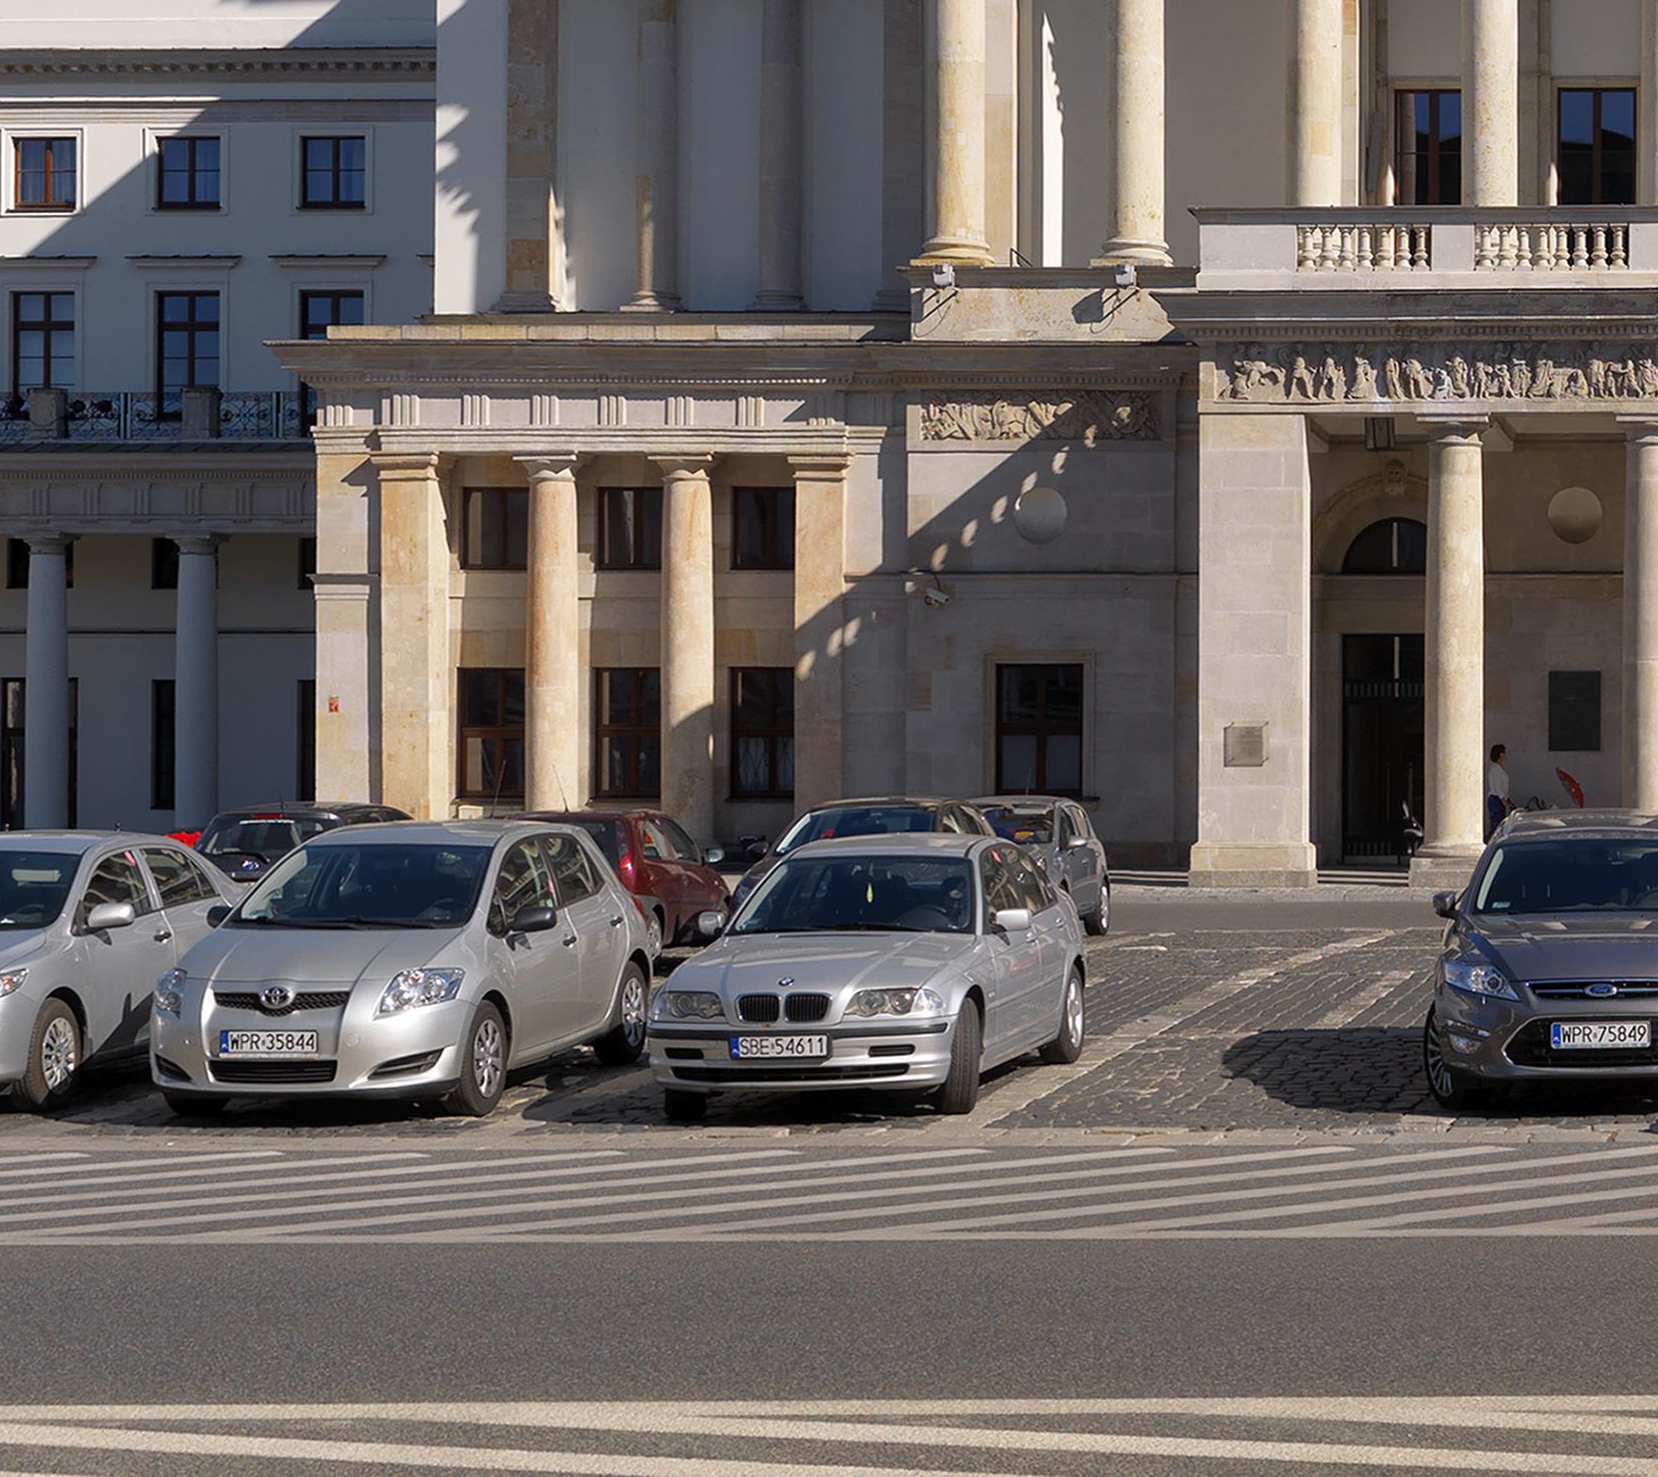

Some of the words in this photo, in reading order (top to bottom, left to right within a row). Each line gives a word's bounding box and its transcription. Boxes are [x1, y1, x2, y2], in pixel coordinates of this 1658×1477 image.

[230, 1035, 260, 1052] WPR
[265, 1033, 315, 1051] 35844
[1562, 1026, 1591, 1043] WPR
[1597, 1025, 1647, 1043] 75849
[739, 1037, 769, 1055] SBE
[774, 1035, 825, 1054] 54611
